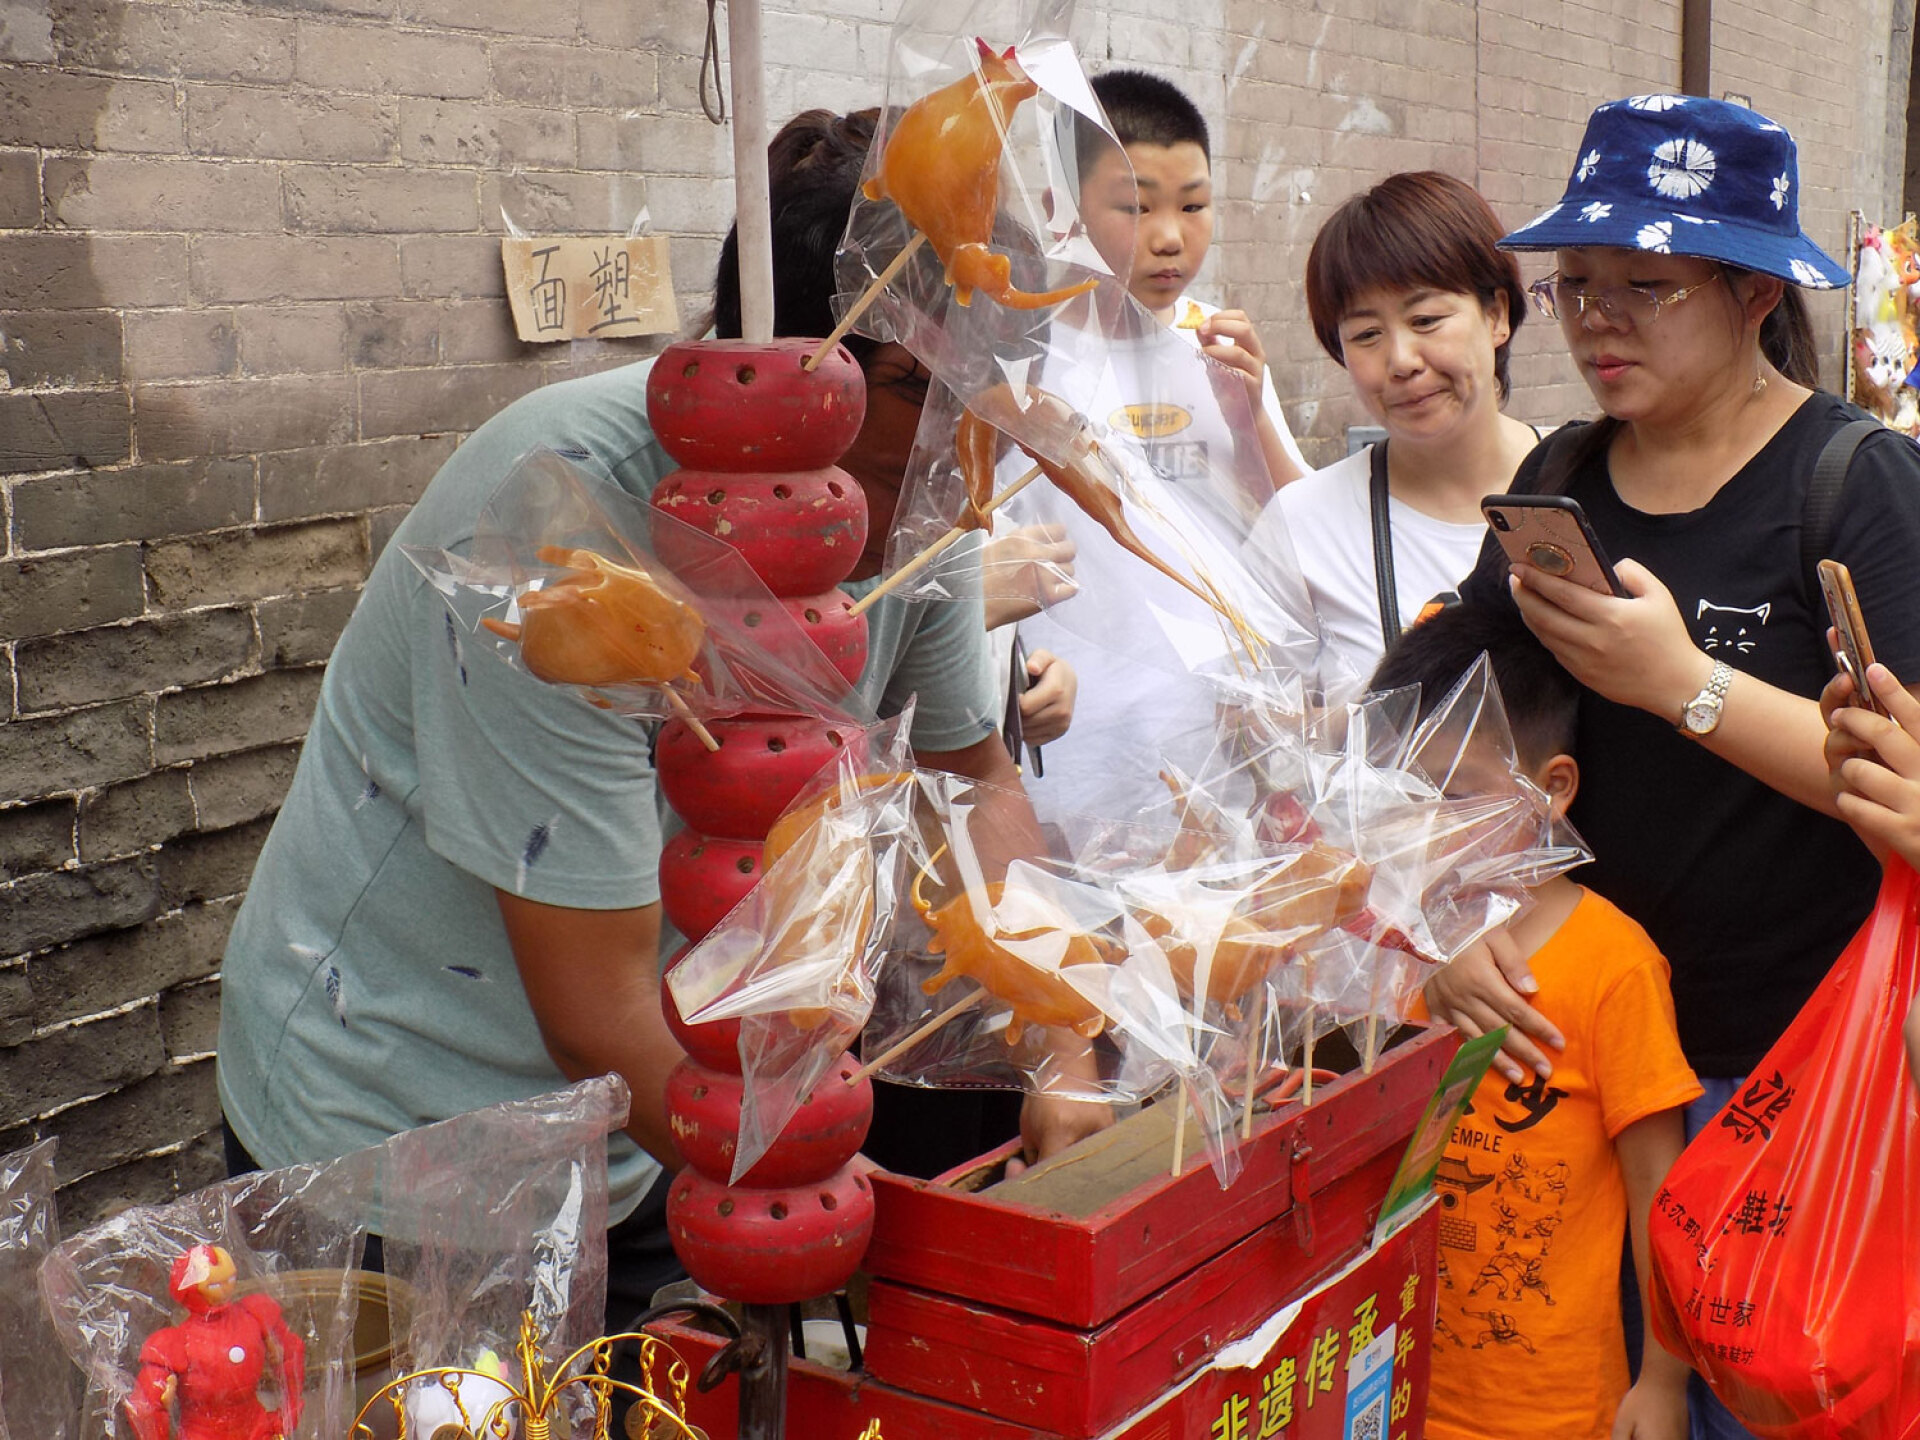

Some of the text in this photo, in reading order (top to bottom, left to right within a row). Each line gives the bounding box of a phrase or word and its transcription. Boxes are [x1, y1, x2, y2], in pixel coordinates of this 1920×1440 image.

[530, 245, 641, 334] 面塑
[1450, 1126, 1503, 1153] EMPLE
[1723, 1189, 1793, 1238] 鞋坊
[1211, 1292, 1379, 1440] 非遗传承
